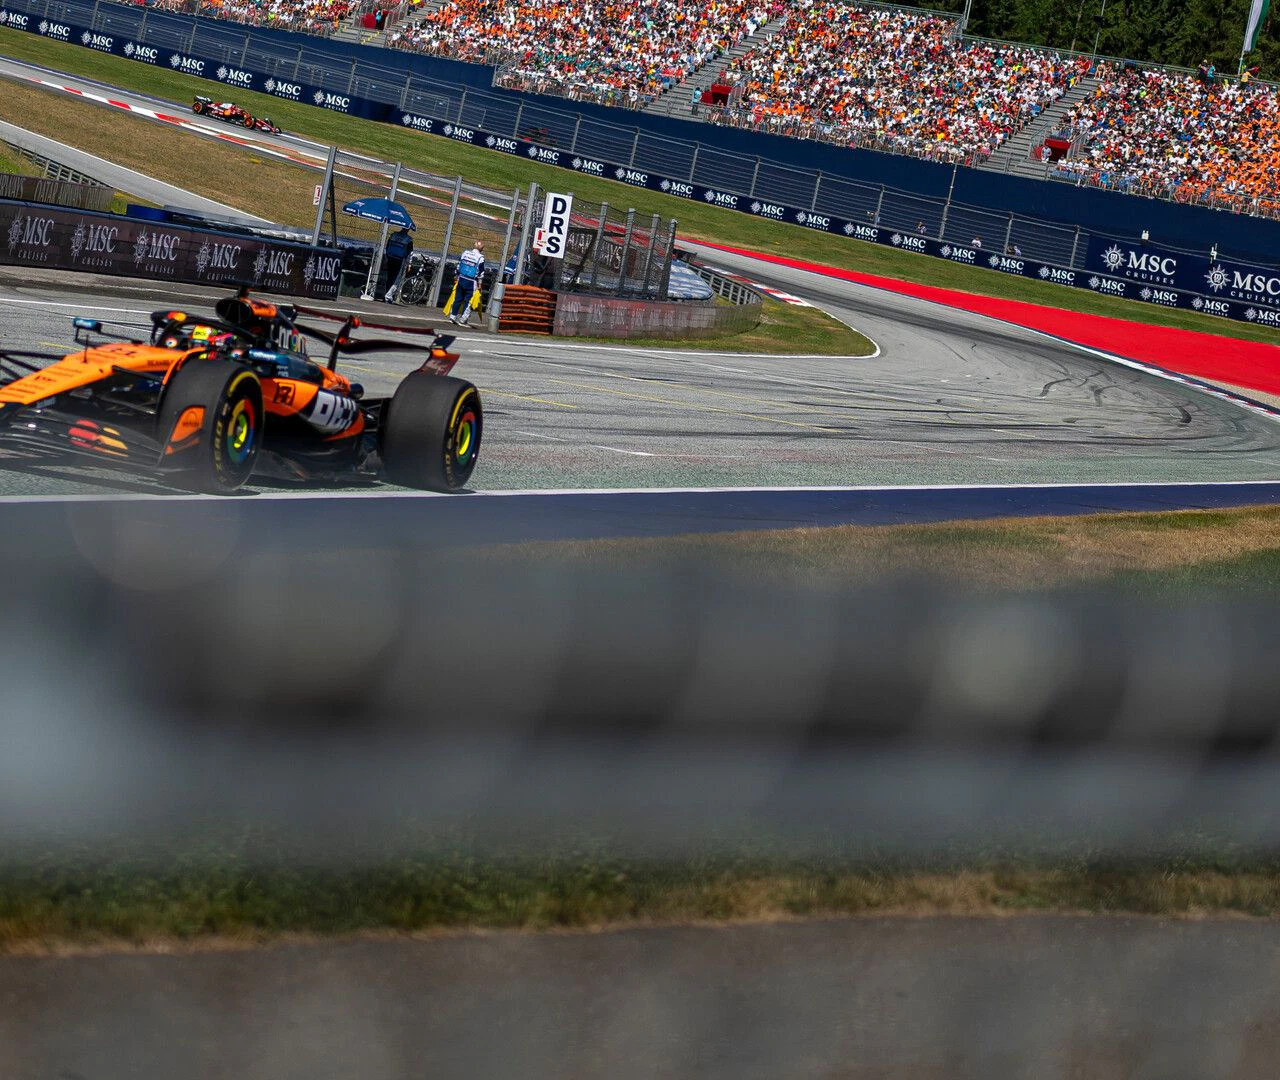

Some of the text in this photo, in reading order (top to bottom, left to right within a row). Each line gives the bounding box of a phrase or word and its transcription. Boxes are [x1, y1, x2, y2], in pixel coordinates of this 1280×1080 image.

[7, 13, 28, 25] MSC
[49, 23, 70, 36] MSC
[92, 34, 112, 47] MSC
[134, 45, 157, 58] MSC
[182, 57, 204, 70] MSC
[228, 69, 252, 83] MSC
[276, 82, 300, 95] MSC
[326, 94, 349, 107] MSC
[412, 117, 432, 128] MSC
[452, 127, 473, 139] MSC
[496, 138, 517, 149] MSC
[538, 149, 559, 160] MSC
[583, 160, 603, 171] MSC
[626, 170, 647, 182] MSC
[670, 182, 693, 194] MSC
[715, 193, 738, 204] MSC
[762, 204, 784, 215] MSC
[546, 197, 566, 254] DRS
[806, 214, 829, 226] MSC
[22, 216, 54, 246] MSC
[856, 226, 878, 237] MSC
[86, 224, 118, 252] MSC
[903, 236, 926, 248] MSC
[148, 232, 181, 261] MSC
[210, 244, 240, 269] MSC
[952, 248, 975, 259] MSC
[267, 251, 294, 276] MSC
[316, 256, 340, 281] MSC
[1001, 258, 1024, 270] MSC
[1127, 251, 1176, 276] MSC
[1050, 269, 1074, 280] MSC
[1126, 270, 1174, 284] CRUISES
[1101, 279, 1125, 291] MSC
[1153, 290, 1177, 302] MSC
[1231, 290, 1280, 304] CRUISES
[1203, 300, 1229, 312] MSC
